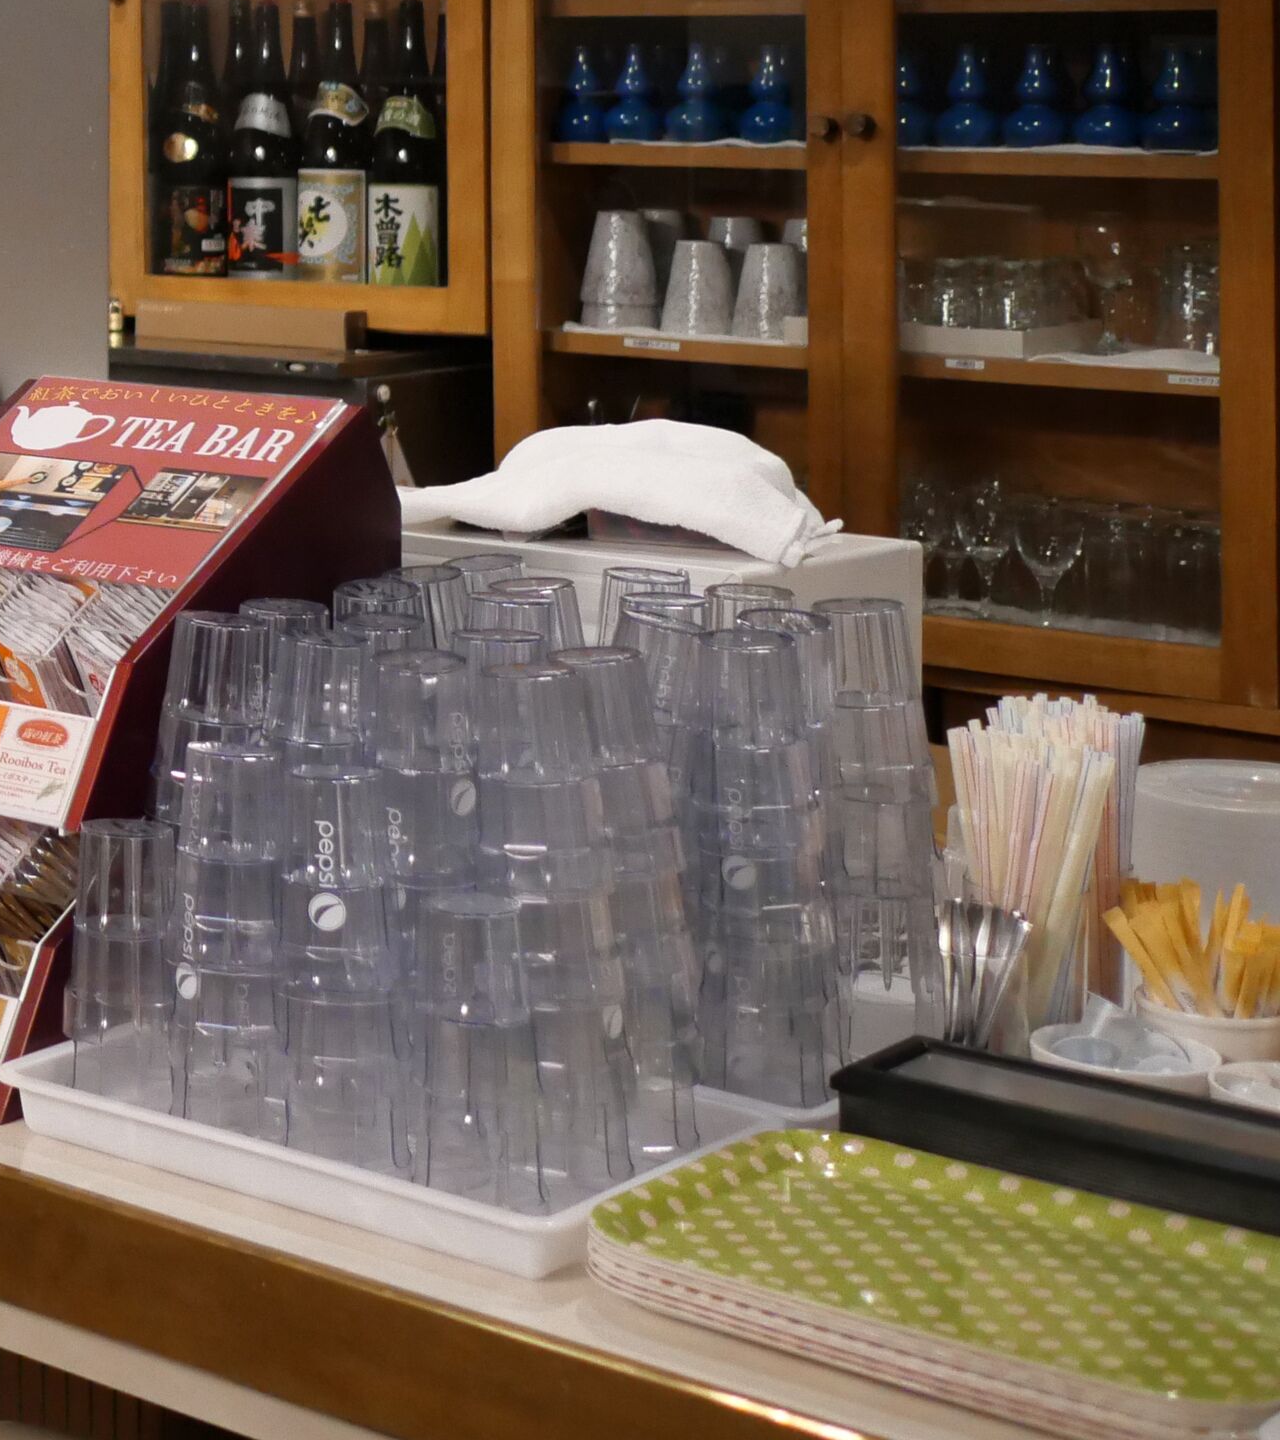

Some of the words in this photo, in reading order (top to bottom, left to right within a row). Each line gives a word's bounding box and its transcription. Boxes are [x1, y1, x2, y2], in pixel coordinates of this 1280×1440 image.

[111, 416, 196, 454] TEA
[194, 424, 295, 463] BAR
[0, 751, 43, 771] Rooibos
[47, 759, 66, 776] Tea
[314, 819, 338, 890] pepsi
[181, 892, 195, 961] pepsi
